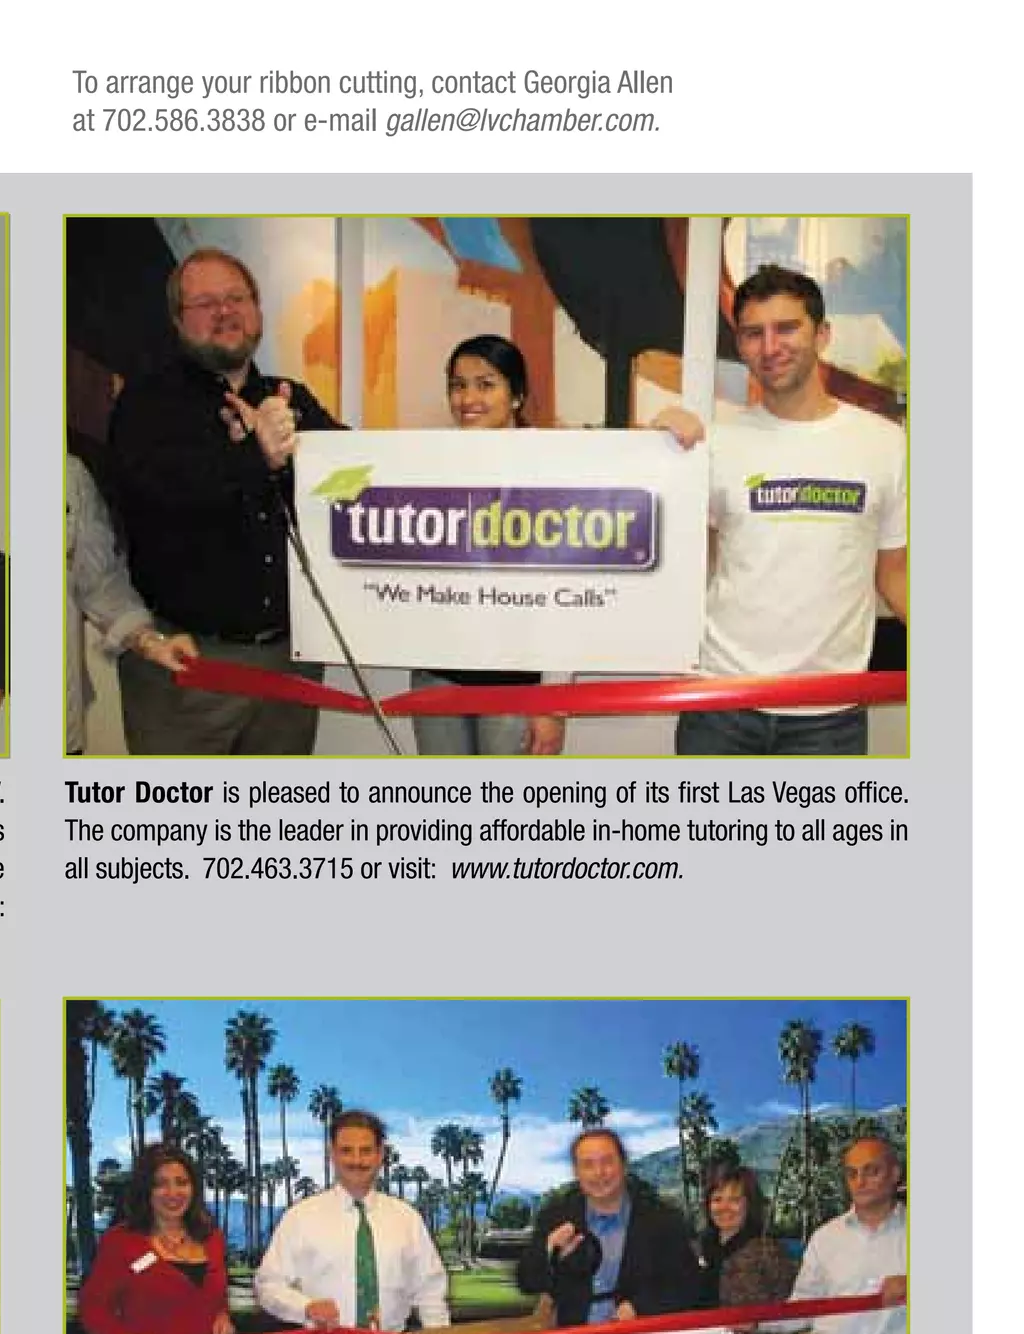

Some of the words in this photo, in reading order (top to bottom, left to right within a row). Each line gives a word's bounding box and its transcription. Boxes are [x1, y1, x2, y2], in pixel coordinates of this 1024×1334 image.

[72, 70, 97, 93] To
[106, 76, 193, 99] arrange
[202, 76, 252, 98] your
[260, 70, 330, 93] ribbon
[340, 70, 423, 99] cutting,
[432, 71, 516, 93] contact
[524, 70, 611, 99] Georgia
[617, 70, 672, 93] Allen
[73, 109, 95, 131] at
[103, 109, 265, 131] 702.586.3838
[274, 113, 296, 131] or
[305, 108, 376, 131] e-mail
[386, 108, 659, 136] gallen@lvchamber.com.
[416, 584, 471, 605] Make
[478, 586, 547, 607] House
[65, 781, 125, 803] Tutor
[136, 781, 213, 803] Doctor
[224, 781, 239, 803] is
[250, 781, 329, 808] pleased
[339, 782, 359, 803] to
[369, 786, 471, 803] announce
[480, 781, 513, 803] the
[523, 781, 606, 808] opening
[616, 781, 636, 803] of
[646, 781, 669, 803] its
[678, 781, 719, 803] first
[729, 781, 765, 803] Las
[772, 781, 835, 808] Vegas
[845, 781, 908, 803] office.
[65, 857, 88, 879] all
[96, 857, 189, 884] subjects.
[203, 857, 353, 879] 702.463.3715
[361, 862, 382, 879] or
[388, 857, 435, 879] visit:
[453, 857, 683, 879] www.tutordoctor.com.
